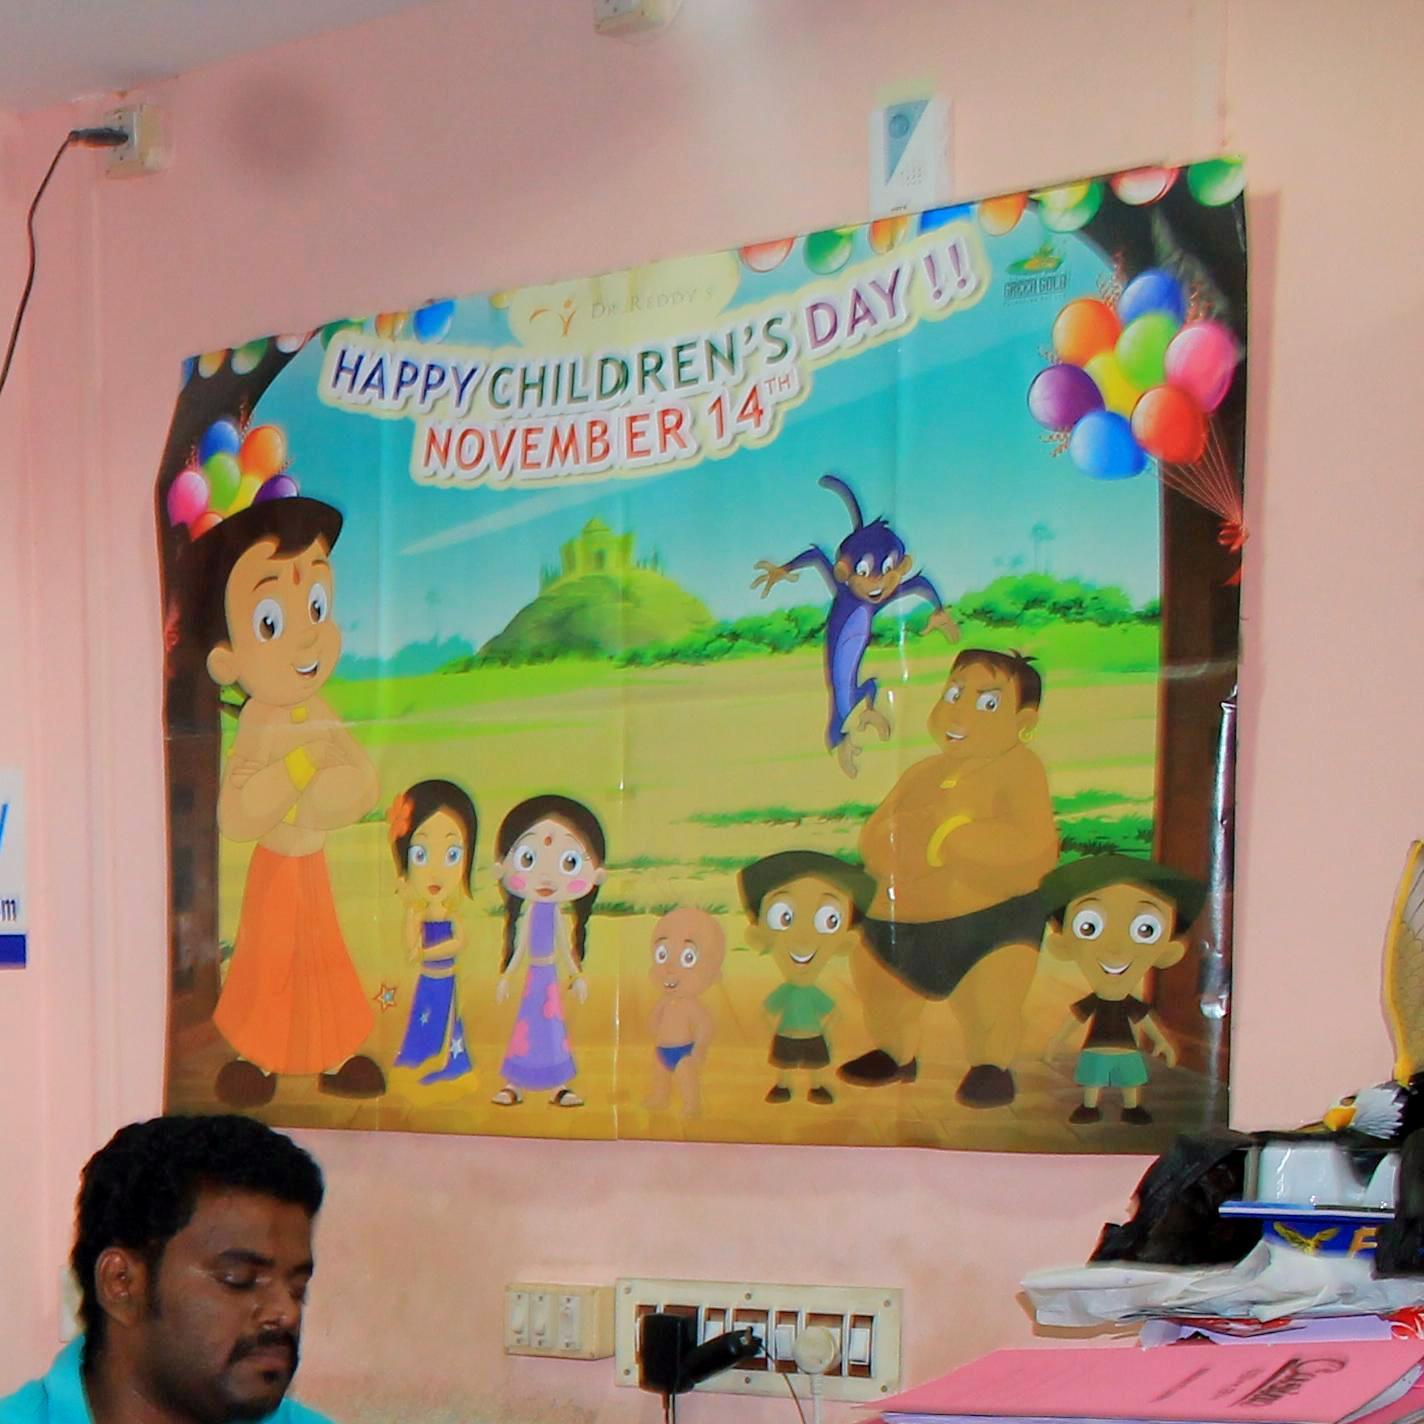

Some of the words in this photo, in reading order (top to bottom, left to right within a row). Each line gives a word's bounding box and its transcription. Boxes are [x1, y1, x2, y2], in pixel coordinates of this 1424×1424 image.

[332, 347, 480, 408] HAPPY
[489, 316, 792, 408] CHILDREN'S
[807, 265, 904, 351] DAY
[422, 412, 688, 472] NOVEMBER
